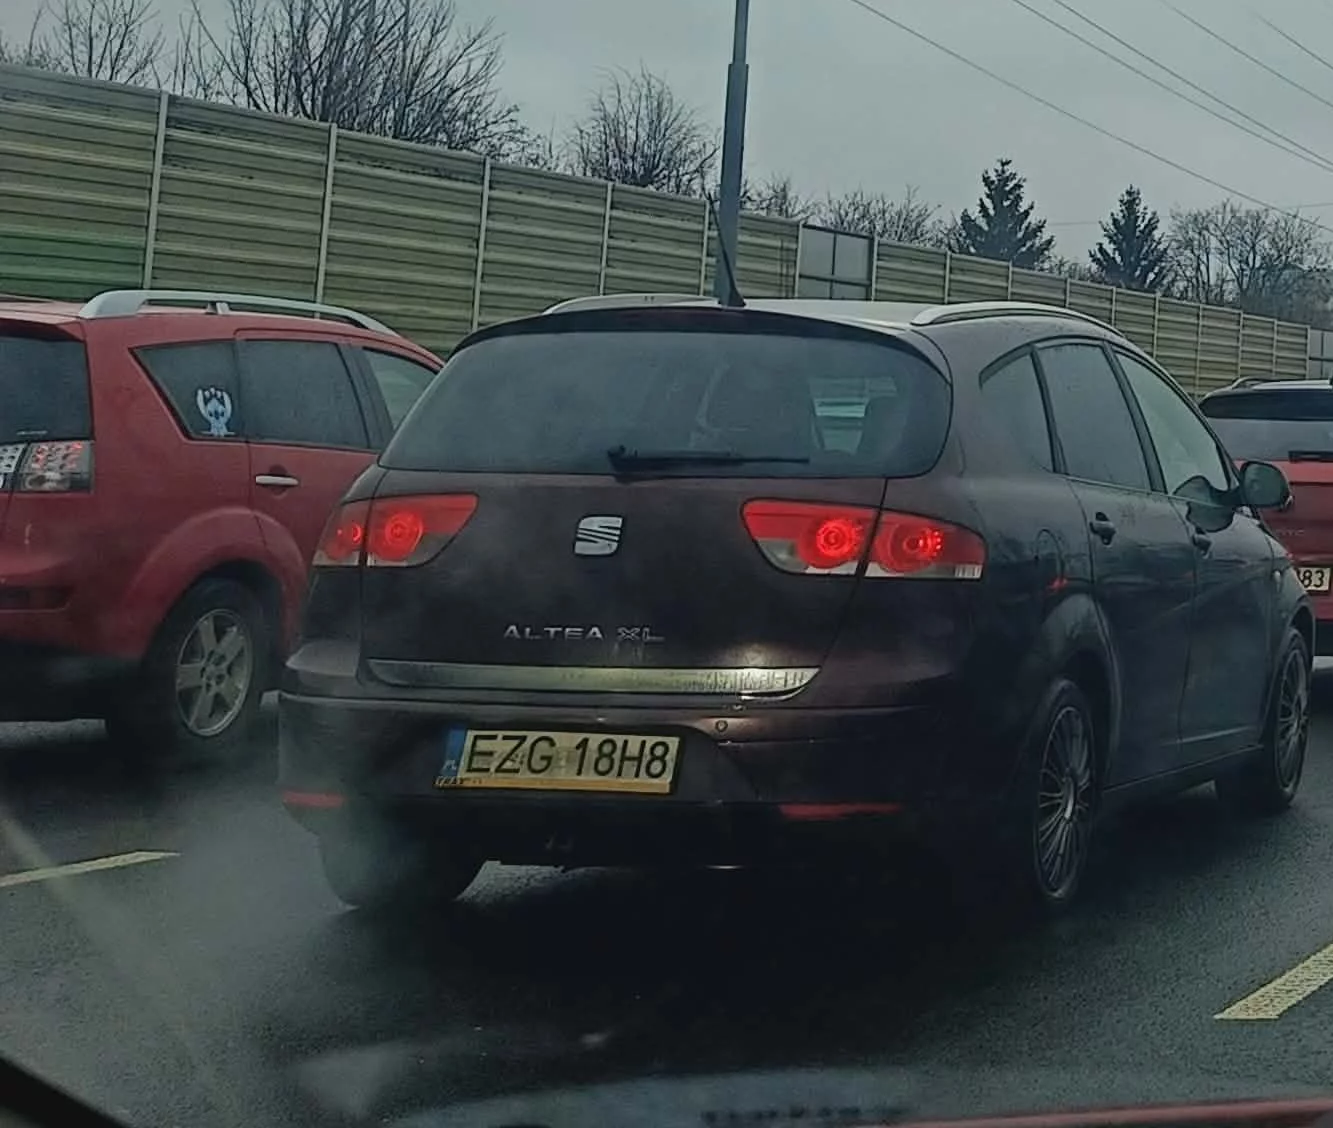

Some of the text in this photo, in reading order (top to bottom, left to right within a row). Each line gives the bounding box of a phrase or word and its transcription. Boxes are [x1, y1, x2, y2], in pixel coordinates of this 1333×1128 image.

[503, 625, 665, 642] ALTEA XL
[466, 735, 670, 779] EZG 18H8
